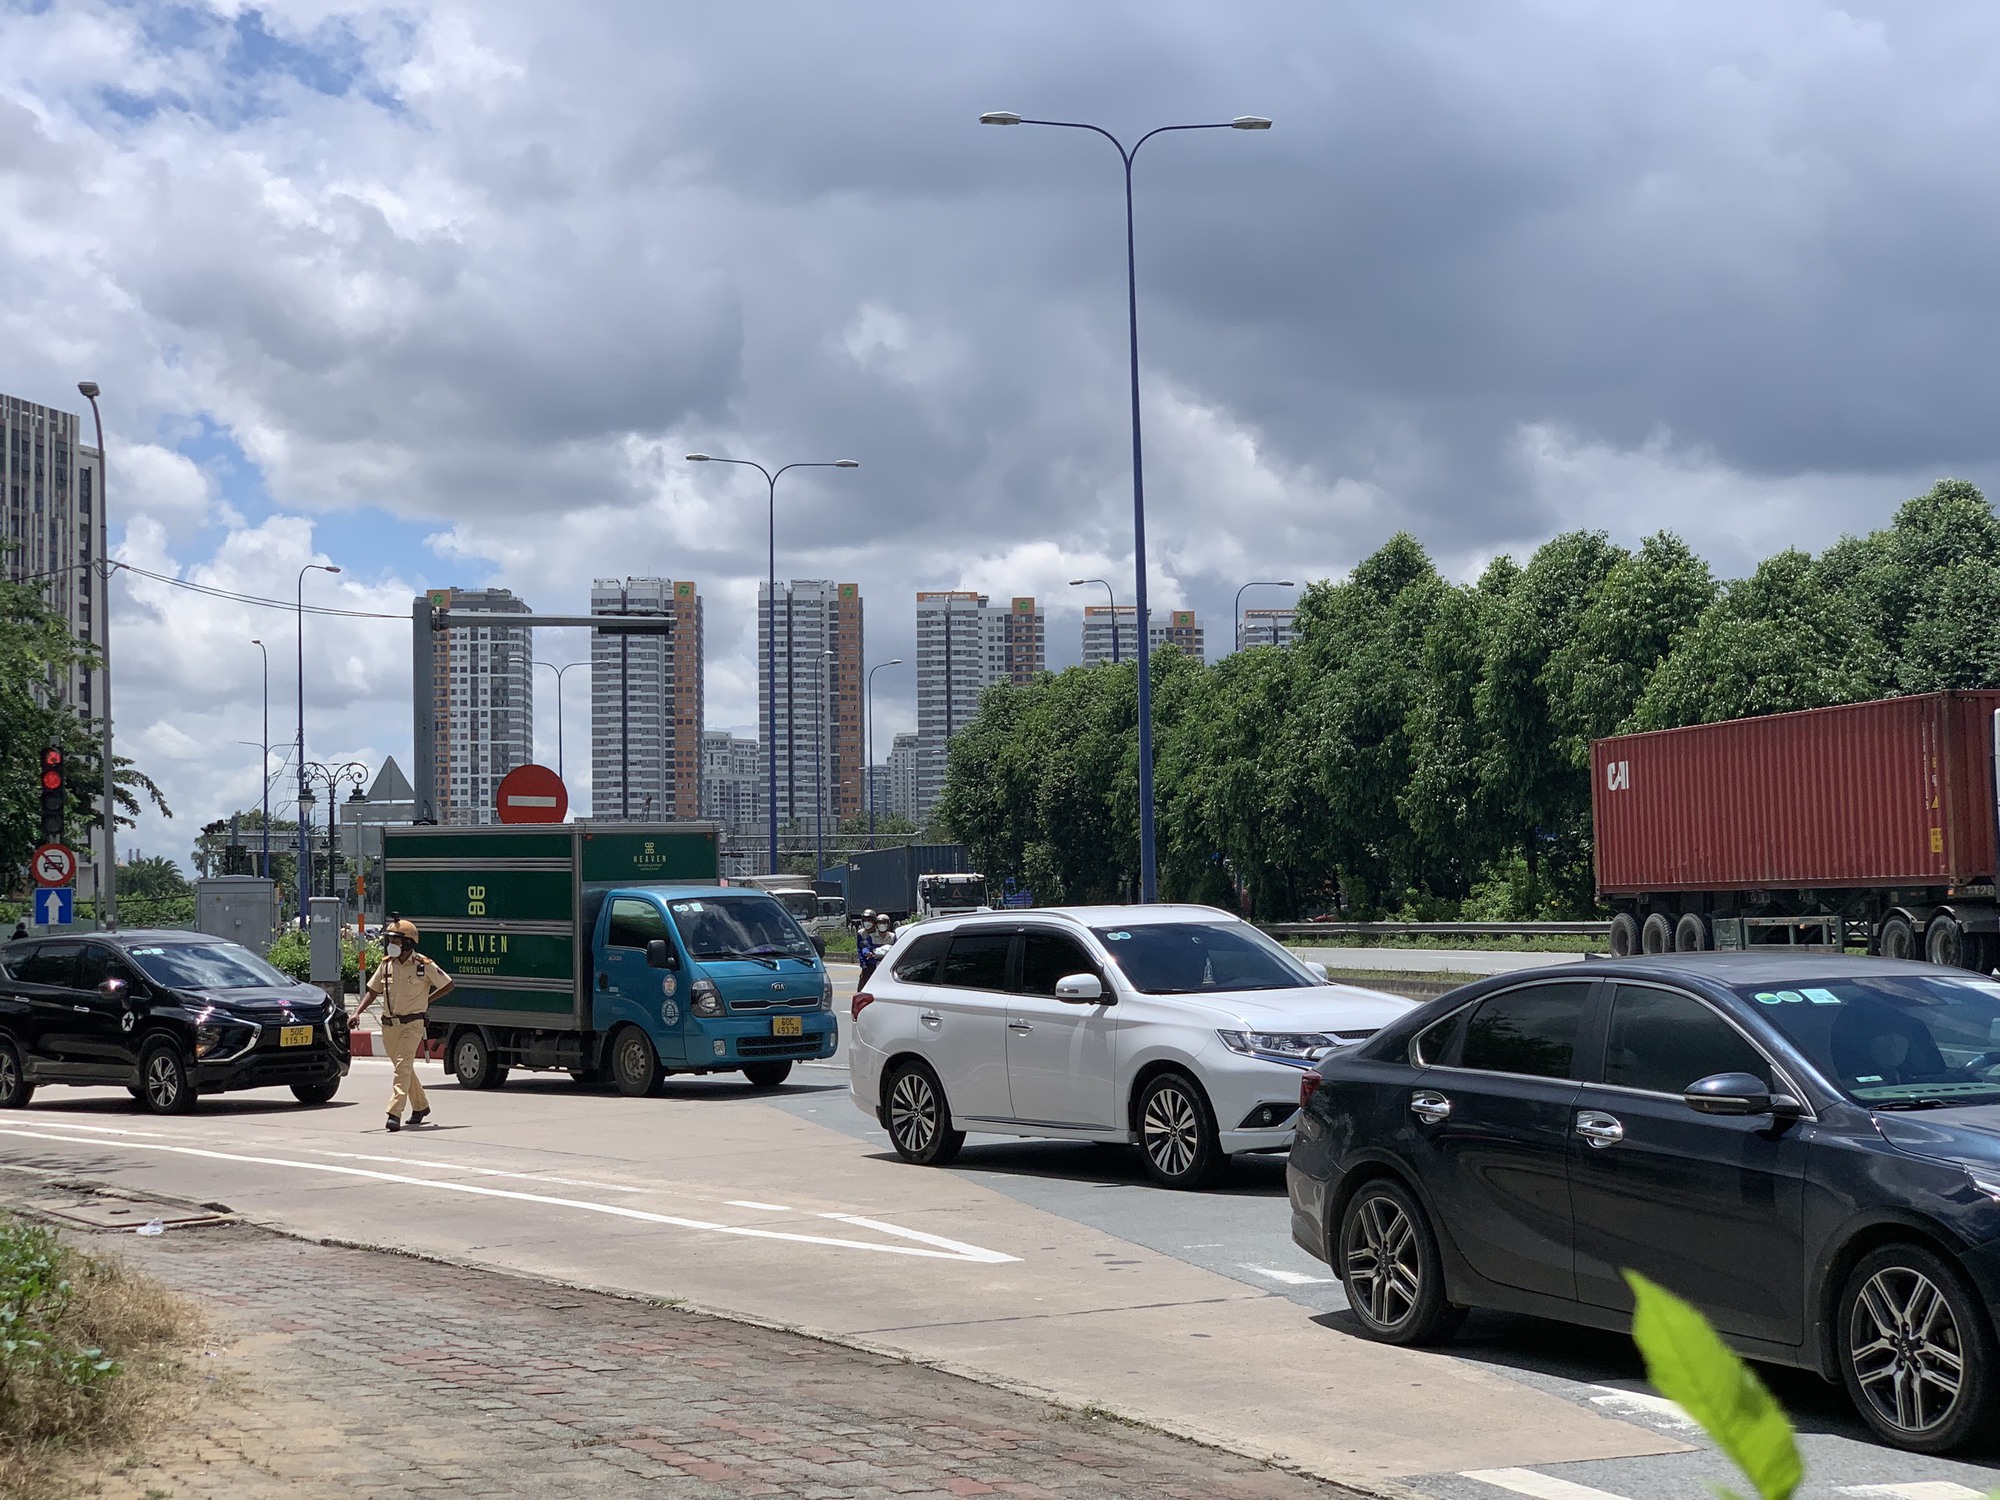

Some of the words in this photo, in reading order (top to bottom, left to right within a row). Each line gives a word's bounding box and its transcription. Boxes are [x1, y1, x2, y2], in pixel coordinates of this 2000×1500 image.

[1607, 760, 1629, 790] CAI
[633, 855, 667, 863] HEAVEN
[446, 933, 508, 953] HEAVEN
[453, 956, 500, 965] IMPORT&EXPORT
[458, 966, 495, 974] CONSULTANT
[781, 1018, 794, 1026] 60C
